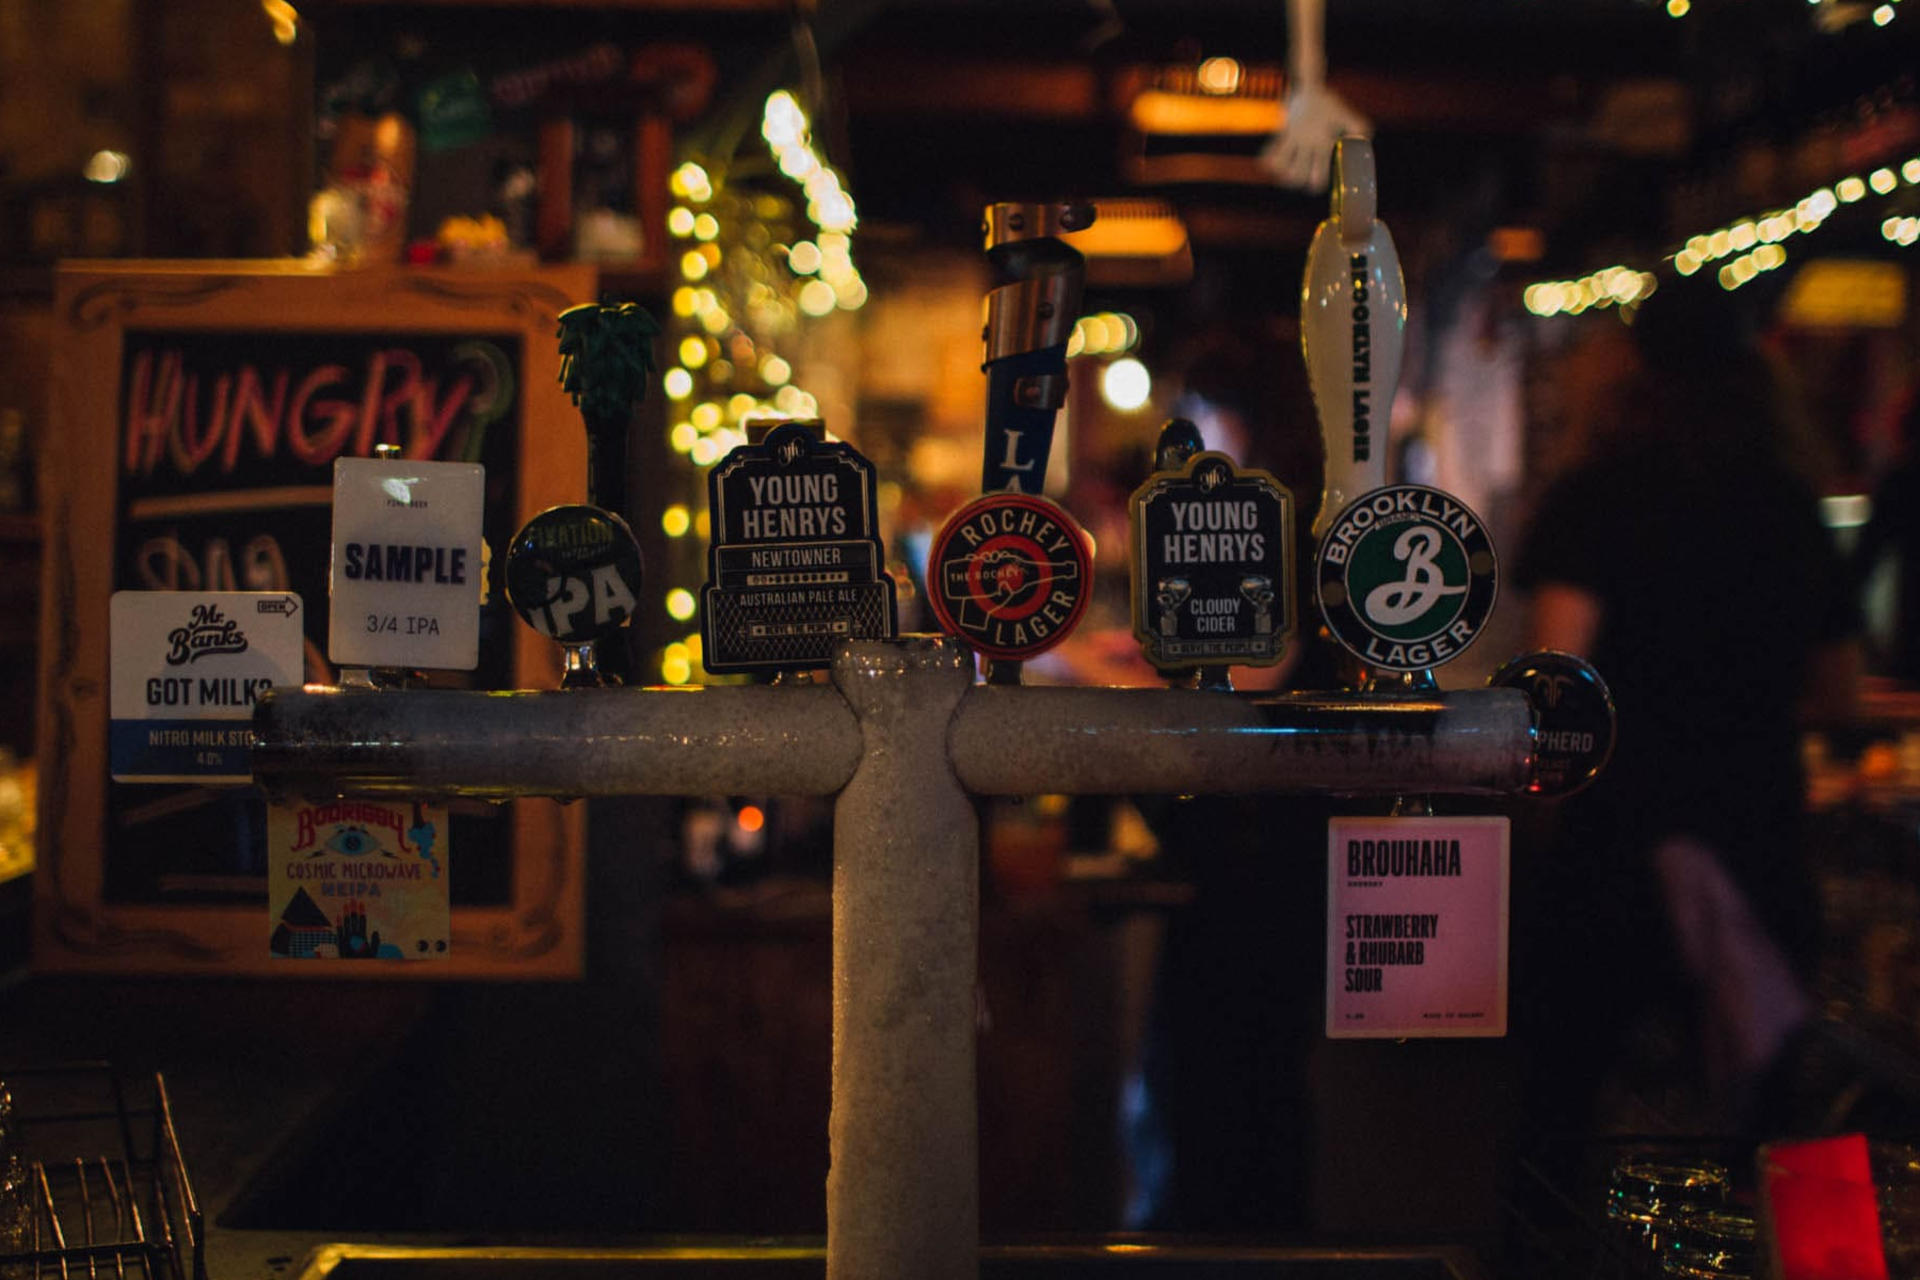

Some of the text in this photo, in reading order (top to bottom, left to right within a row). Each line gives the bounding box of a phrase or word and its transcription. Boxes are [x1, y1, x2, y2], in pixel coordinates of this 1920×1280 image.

[1353, 390, 1371, 463] LAGER
[749, 473, 839, 506] YOUNG
[742, 506, 848, 539] HENRYS
[961, 509, 1072, 553] ROCHEY
[1171, 501, 1258, 532] YOUNG
[1326, 491, 1478, 565] BROOKLYN
[751, 547, 841, 568] NEWTOWNER
[1164, 533, 1266, 563] HENRYS
[345, 543, 467, 585] SAMPLE
[527, 563, 637, 638] IPA
[740, 588, 858, 607] AUSTRALIAN PALE ALE
[1190, 598, 1241, 616] CLOUDY
[189, 604, 224, 629] Mr.
[366, 614, 440, 636] 3/4 IPA
[994, 591, 1076, 646] LAGER
[1197, 616, 1236, 633] CIDER
[167, 621, 248, 666] Banks
[1365, 618, 1475, 665] LAGER
[147, 678, 193, 706] GOT
[149, 730, 257, 747] NITRO MILK STO
[287, 863, 421, 880] COSMIC MICROWAVE
[1347, 840, 1461, 877] BROUHAHA
[1346, 915, 1438, 939] STRAWBERRY
[1345, 942, 1424, 965] & RHUBARB
[1345, 968, 1382, 992] SOUR
